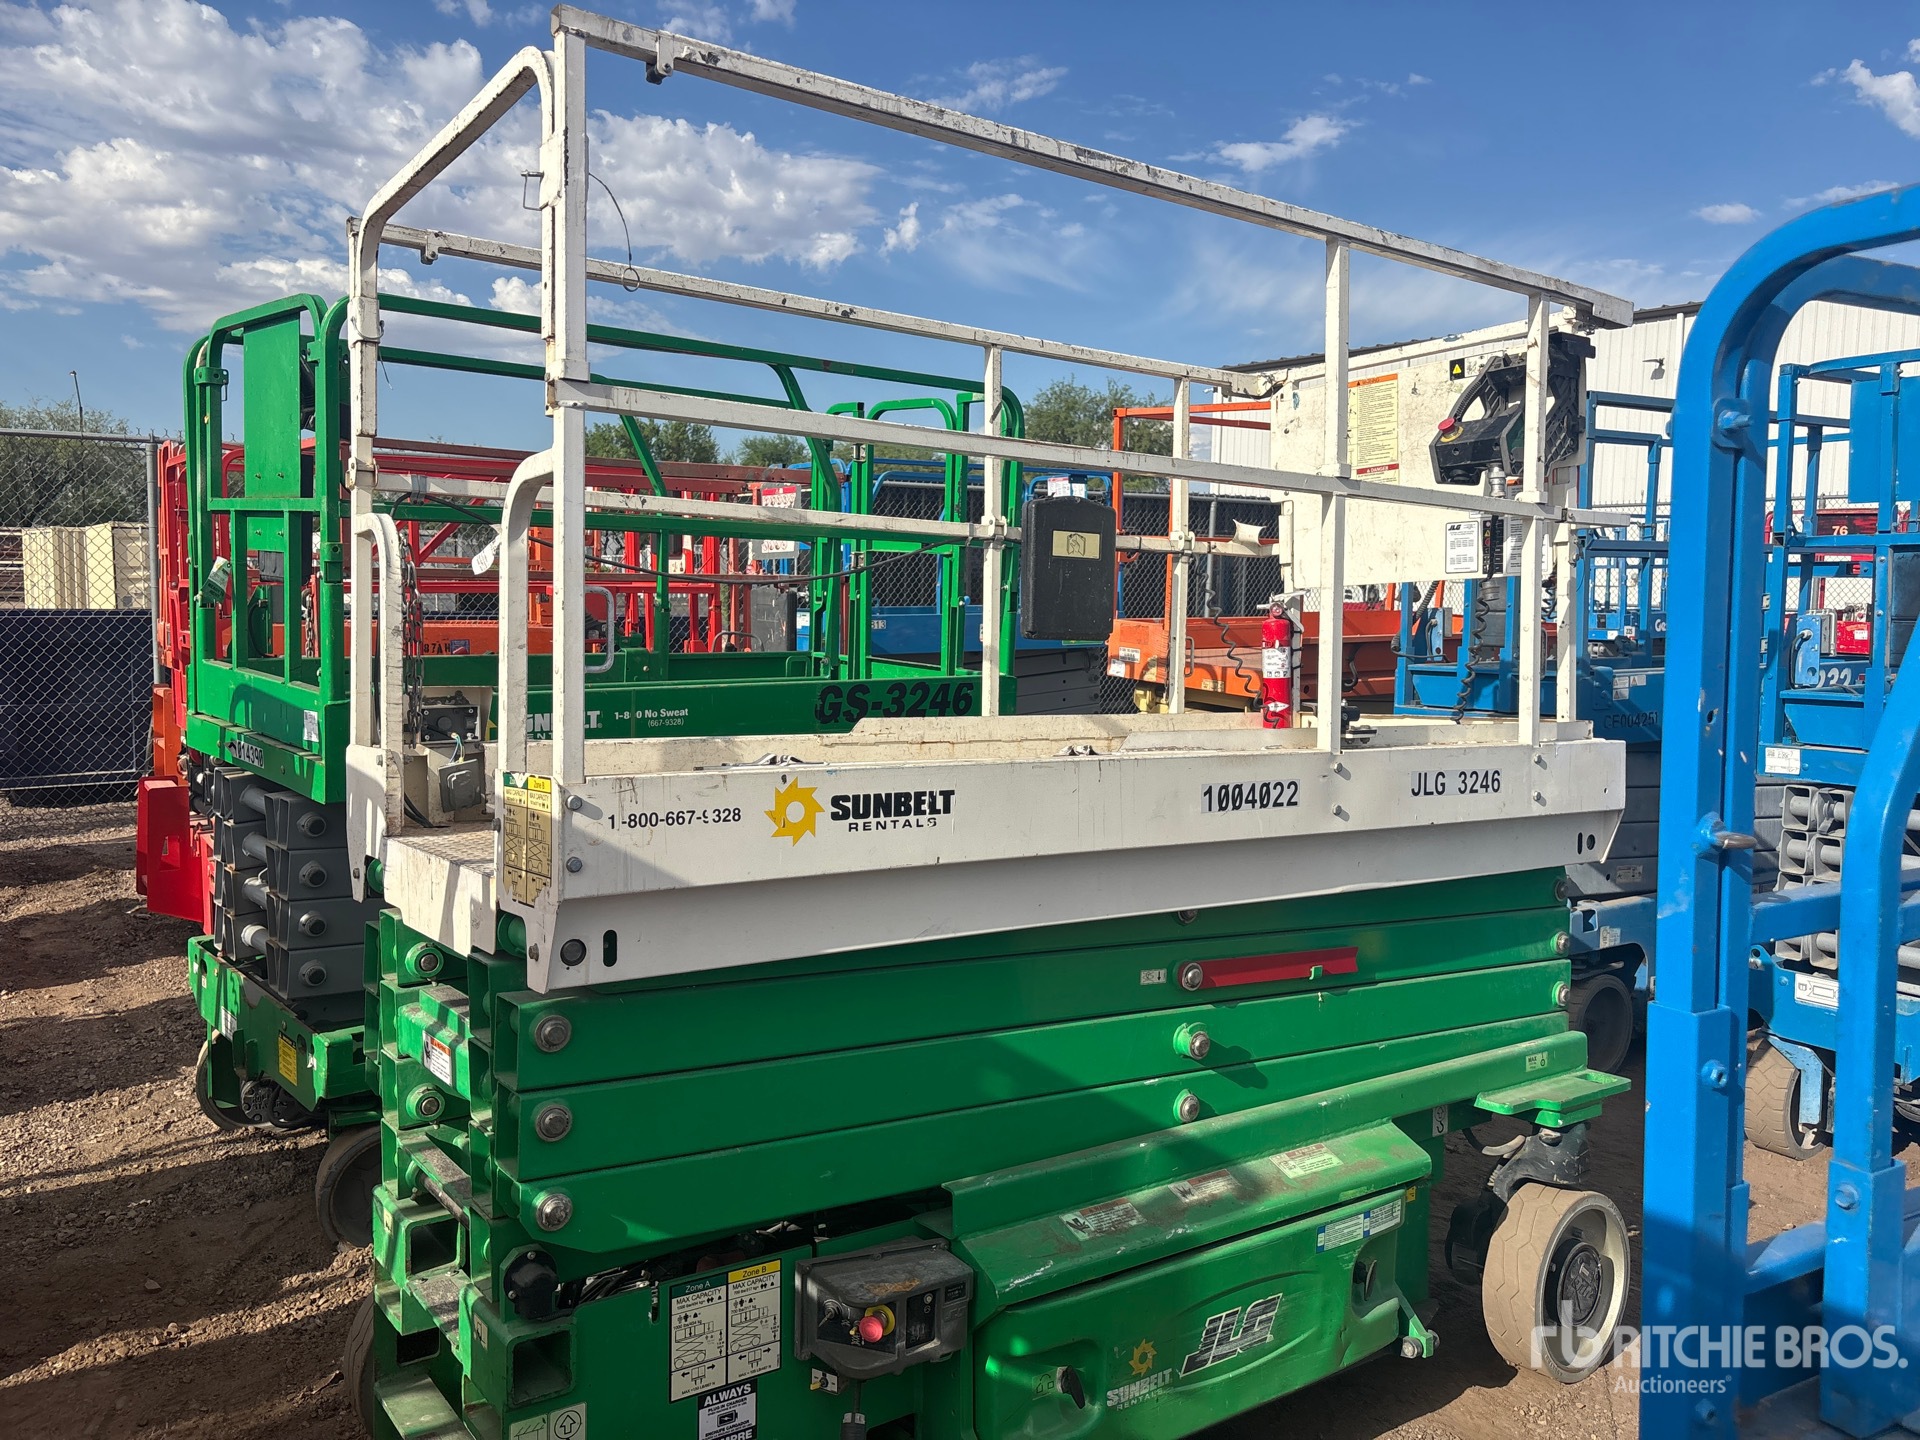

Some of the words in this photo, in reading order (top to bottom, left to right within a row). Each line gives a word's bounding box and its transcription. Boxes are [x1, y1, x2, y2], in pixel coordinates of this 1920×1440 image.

[1832, 525, 1848, 536] 76
[814, 682, 974, 724] GS-3246
[644, 709, 658, 718] No
[659, 708, 689, 717] Sweat
[647, 718, 685, 727] (667-9328)
[1411, 770, 1446, 797] JLG
[1457, 769, 1501, 794] 3246
[1203, 780, 1299, 812] 1004022
[830, 789, 956, 821] SUNBELT
[848, 817, 938, 832] RENTALS
[742, 1268, 760, 1278] Zone
[761, 1265, 767, 1273] B
[685, 1283, 704, 1293] Zone
[704, 1280, 711, 1288] A
[732, 1281, 746, 1290] MAX
[746, 1274, 776, 1286] CAPACITY
[676, 1295, 691, 1305] MAX
[691, 1288, 722, 1301] CAPACITY
[1180, 1292, 1283, 1378] JLG
[704, 1383, 752, 1407] ALWAYS
[1106, 1367, 1173, 1407] SUNBELT
